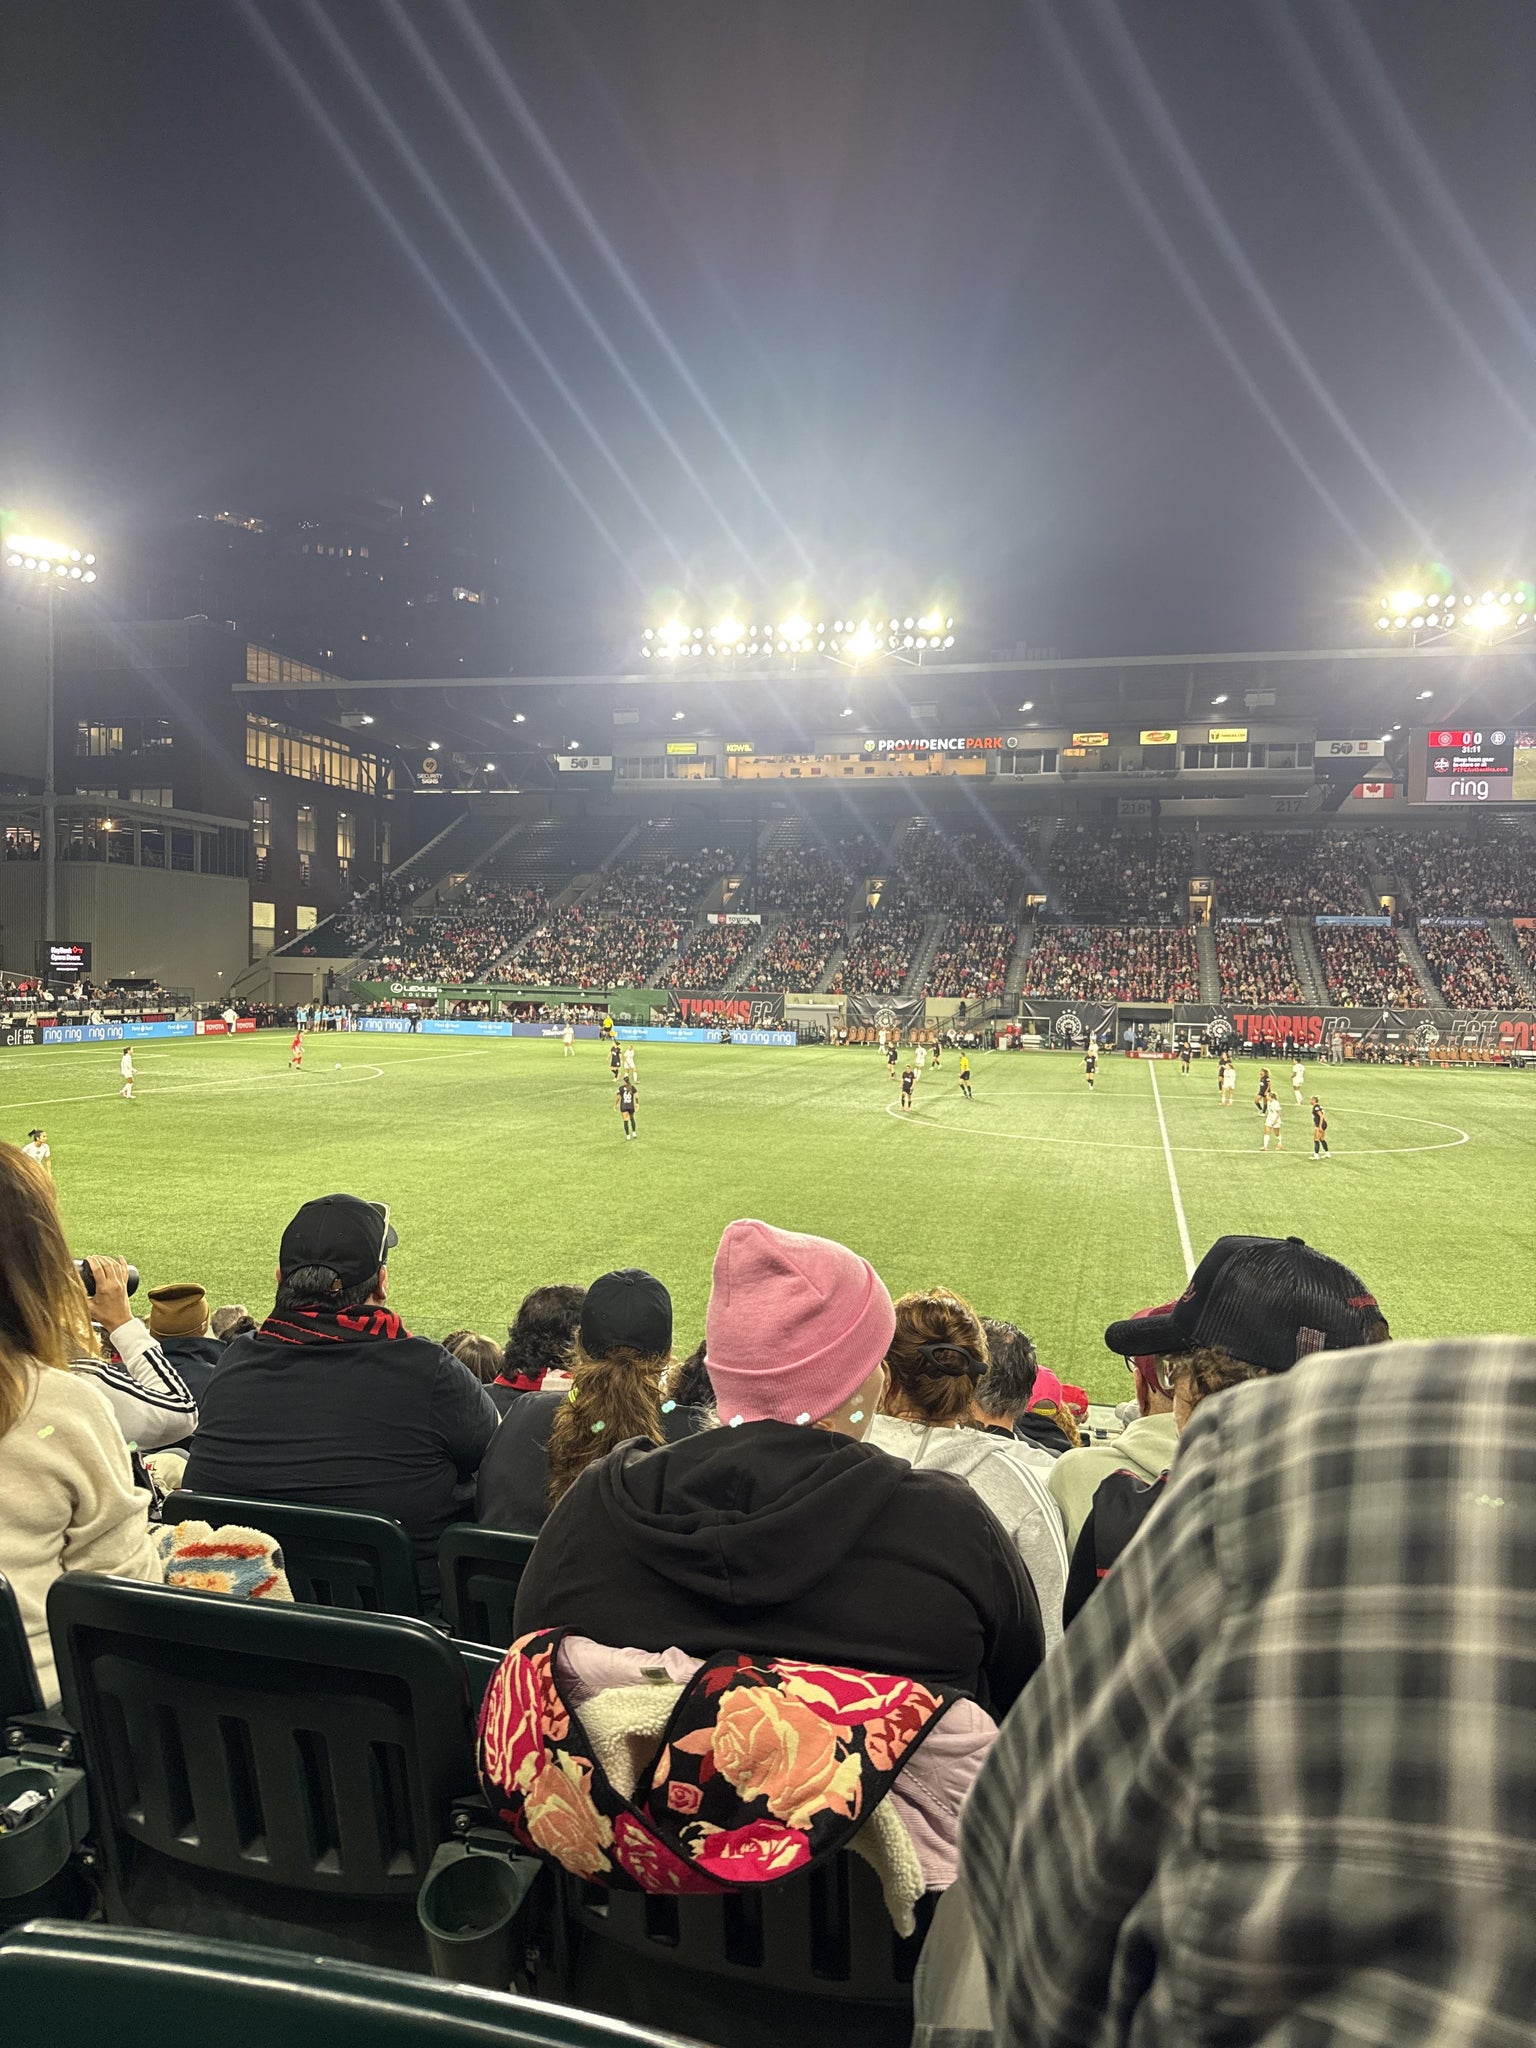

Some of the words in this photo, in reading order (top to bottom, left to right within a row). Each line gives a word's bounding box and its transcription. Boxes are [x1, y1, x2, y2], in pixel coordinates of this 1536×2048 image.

[1462, 733, 1471, 745] 0
[1473, 733, 1482, 744] 0
[1461, 745, 1481, 753] 31:11
[1450, 778, 1489, 800] ring
[1276, 800, 1301, 812] 217
[679, 998, 750, 1024] THORNS
[45, 1027, 62, 1042] ring
[65, 1027, 82, 1041] ring
[88, 1026, 105, 1040] ring
[107, 1025, 123, 1039] ring
[365, 1019, 382, 1032] ring
[385, 1020, 402, 1033] ring
[1233, 1014, 1322, 1043] THORNS
[7, 1029, 22, 1046] elf
[750, 1031, 770, 1044] ring
[772, 1032, 792, 1045] ring
